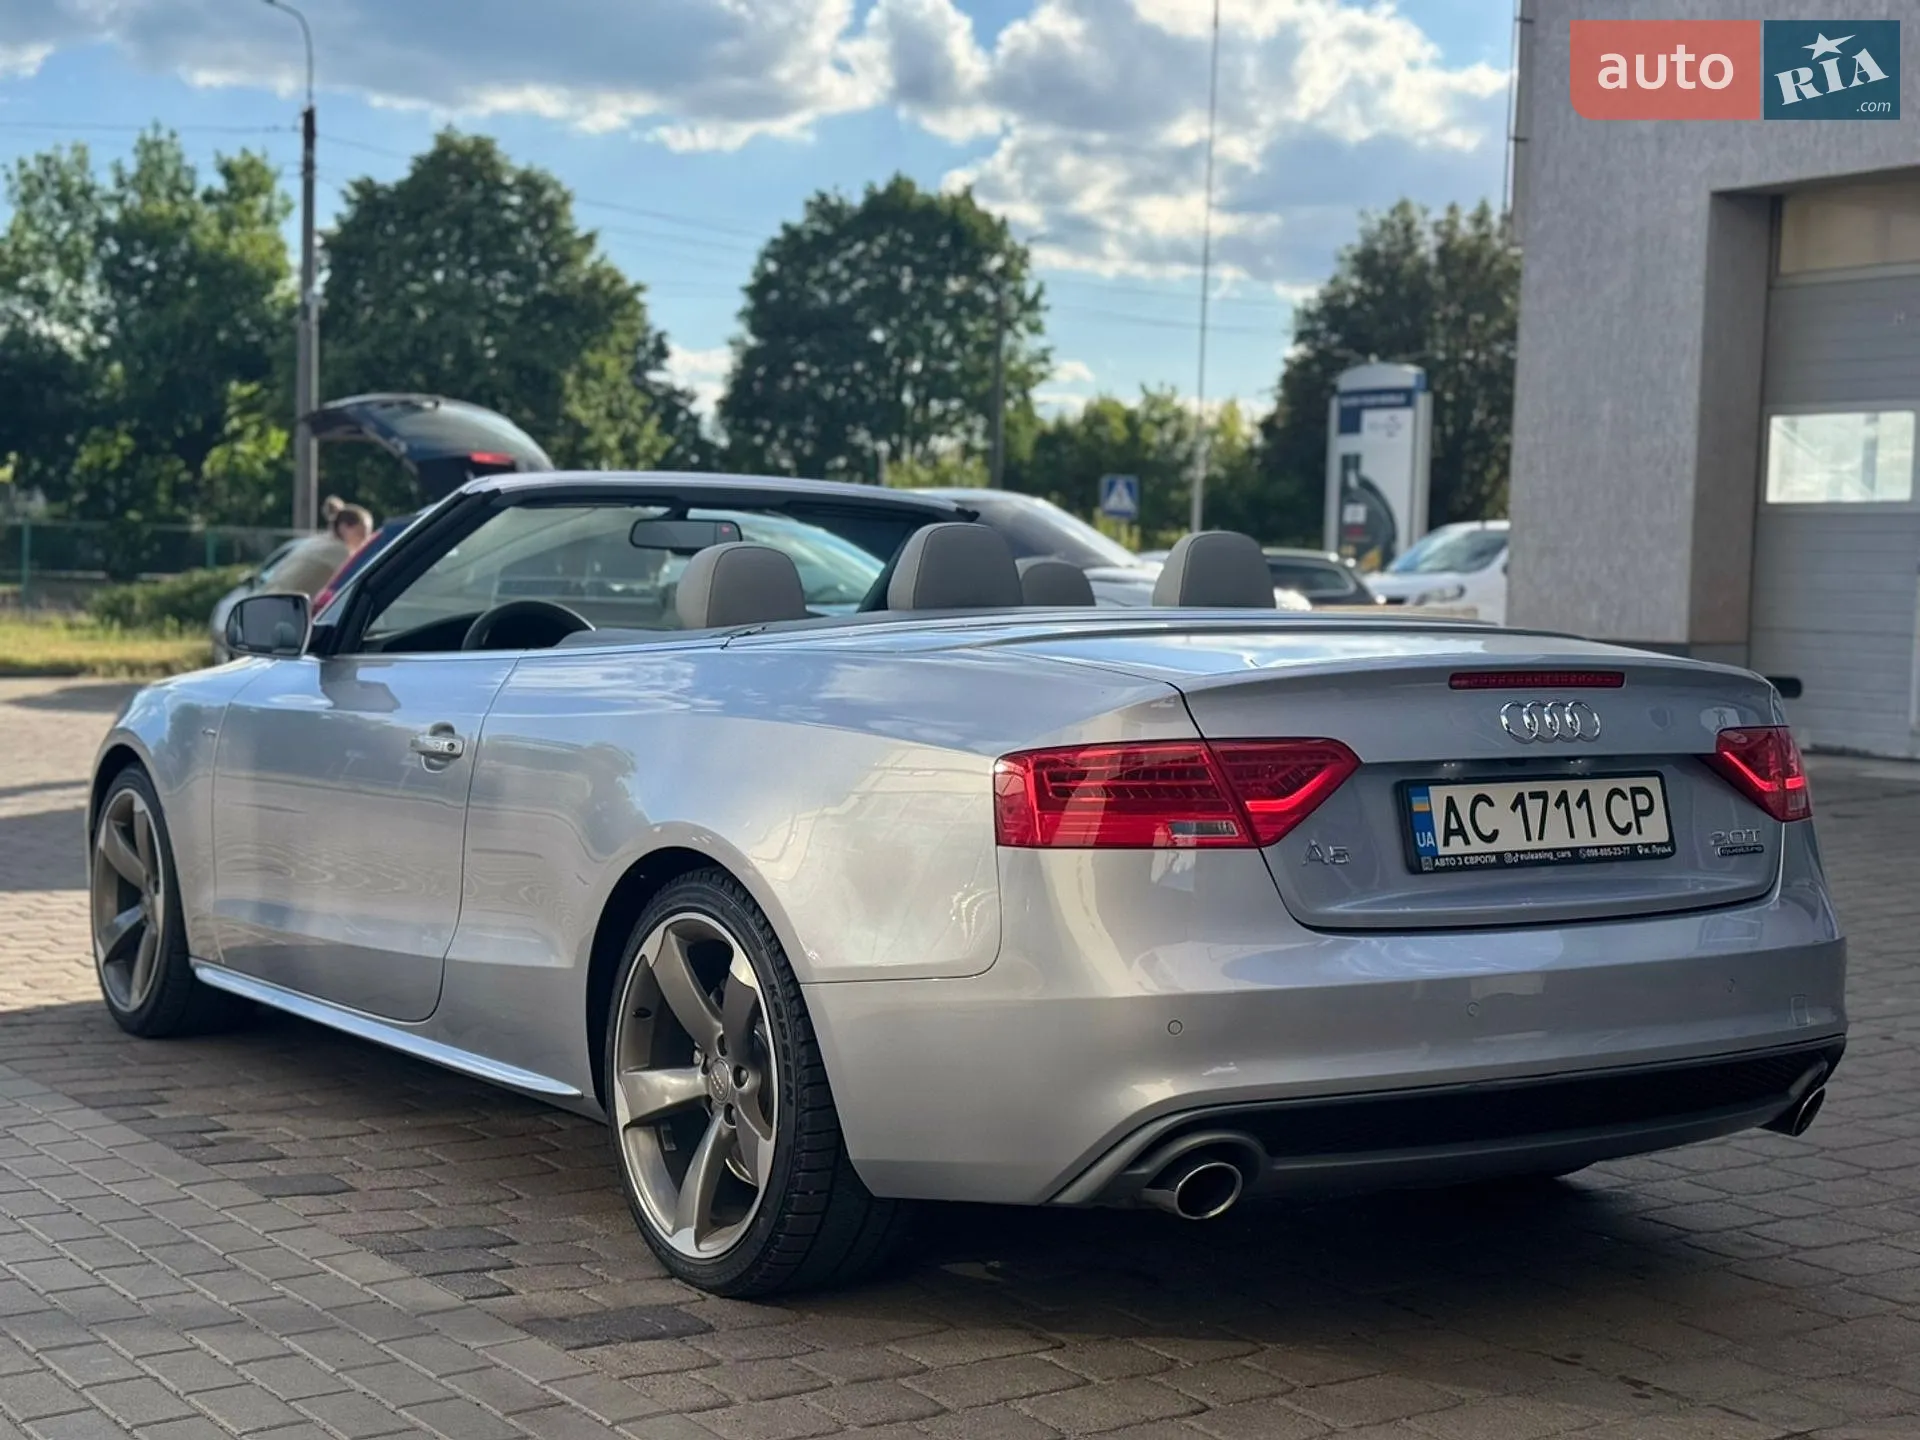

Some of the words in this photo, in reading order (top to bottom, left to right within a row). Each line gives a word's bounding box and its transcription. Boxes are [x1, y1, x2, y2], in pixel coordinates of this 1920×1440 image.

[1442, 793, 1500, 848] AC
[1510, 788, 1597, 842] 1711
[1605, 786, 1655, 836] CP
[1417, 832, 1435, 848] UA
[1302, 839, 1350, 866] A5
[1434, 857, 1456, 867] АВТО
